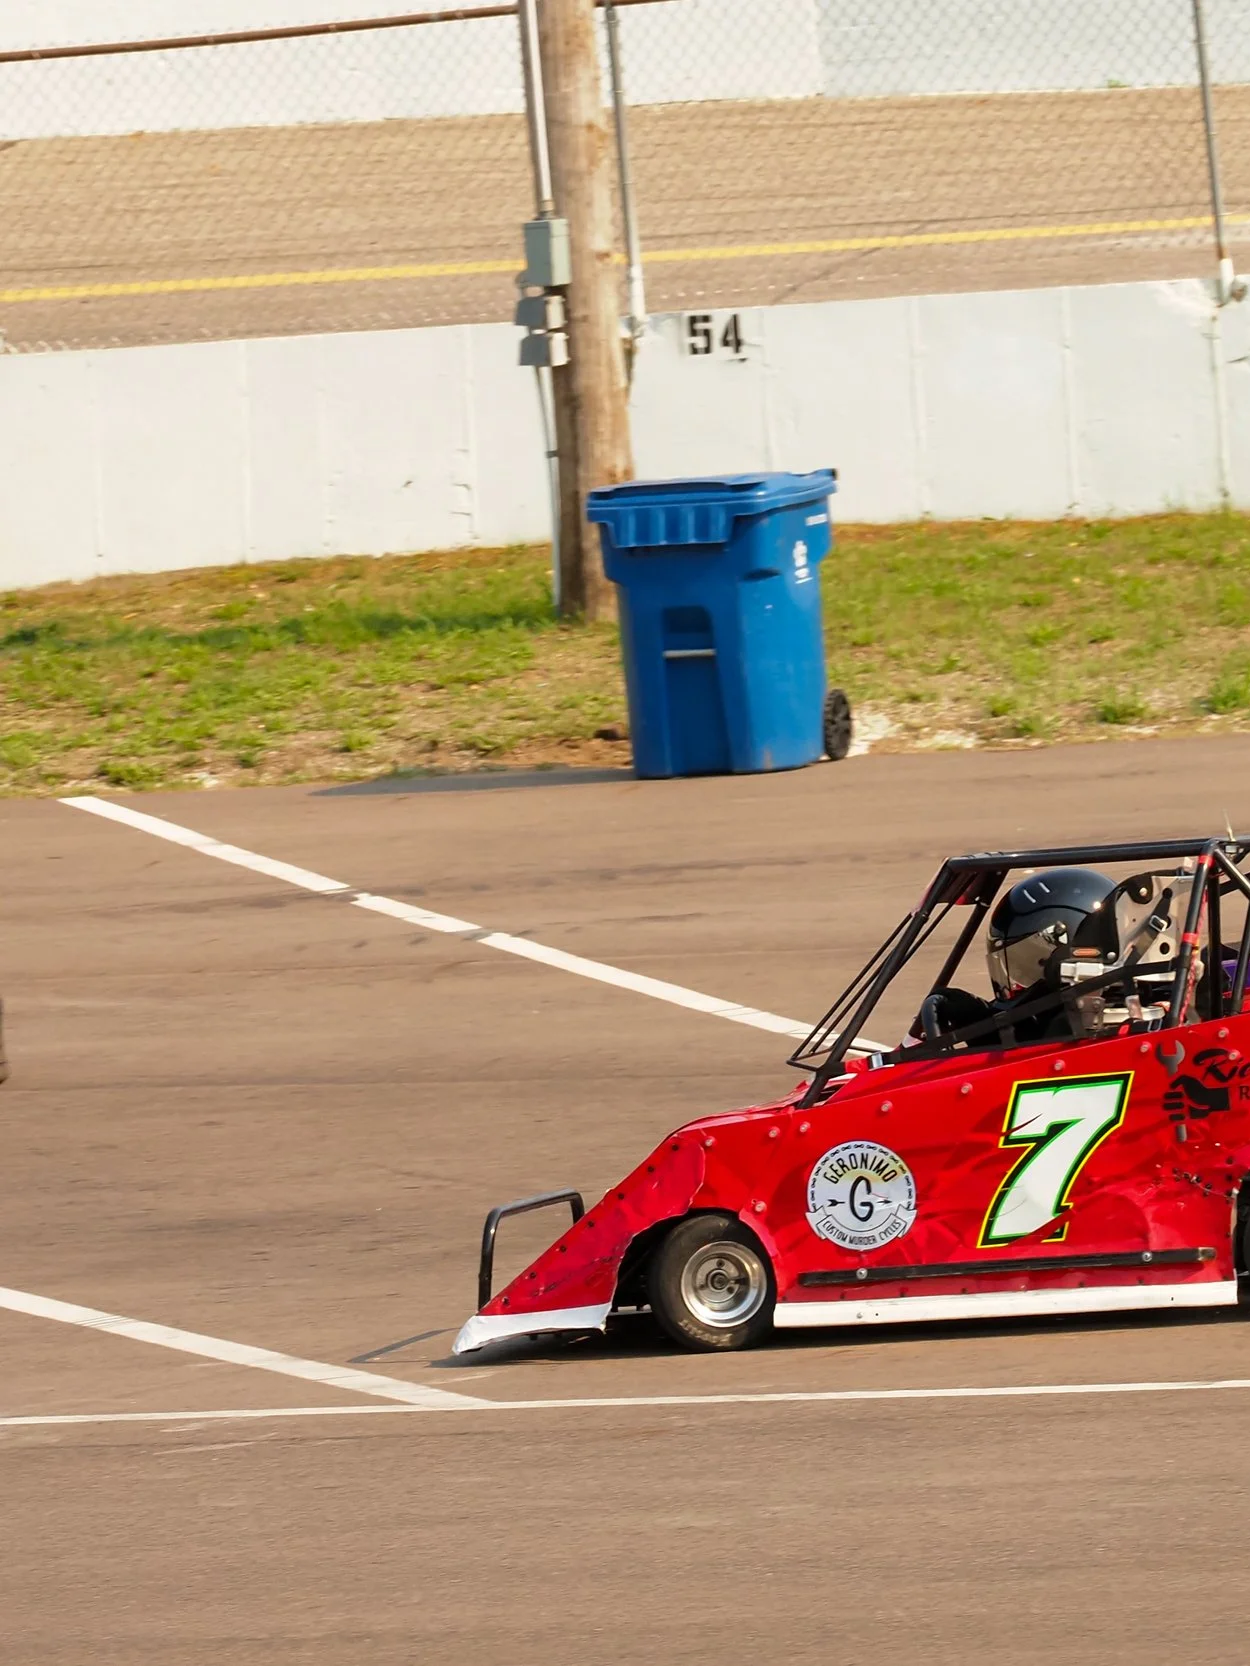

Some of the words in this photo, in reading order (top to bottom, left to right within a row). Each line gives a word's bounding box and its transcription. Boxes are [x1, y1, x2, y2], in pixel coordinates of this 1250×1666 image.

[687, 313, 743, 355] 54
[823, 1152, 898, 1185] GERONIMO
[976, 1070, 1136, 1249] 7
[849, 1175, 875, 1223] G
[822, 1220, 849, 1243] CUSTOM
[878, 1219, 902, 1241] CYCLES
